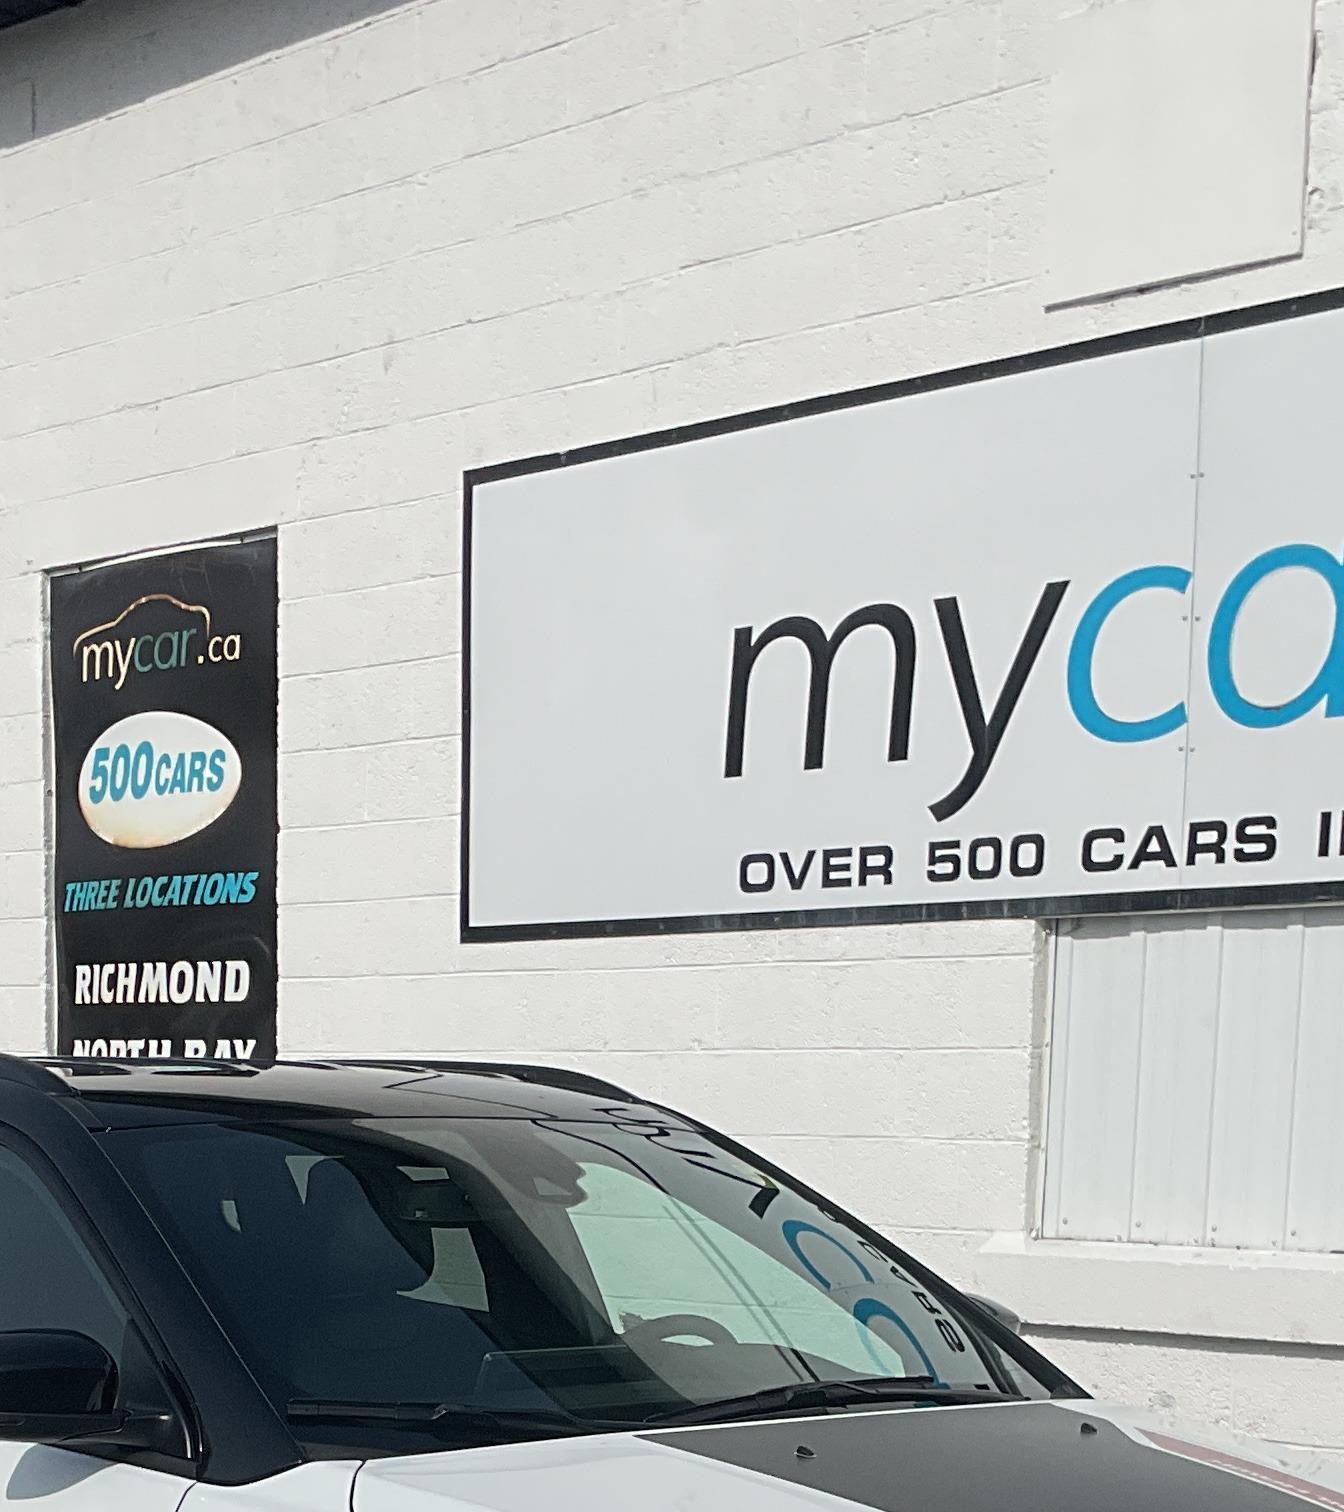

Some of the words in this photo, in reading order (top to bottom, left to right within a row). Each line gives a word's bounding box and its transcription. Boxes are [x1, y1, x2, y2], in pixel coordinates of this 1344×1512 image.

[82, 628, 241, 691] mycar.ca
[739, 845, 894, 894] OVER
[926, 833, 1045, 883] 500
[1081, 815, 1277, 873] CARS
[64, 879, 121, 913] THREE
[124, 871, 259, 909] LOCATIONS
[74, 960, 251, 1005] RICHMOND
